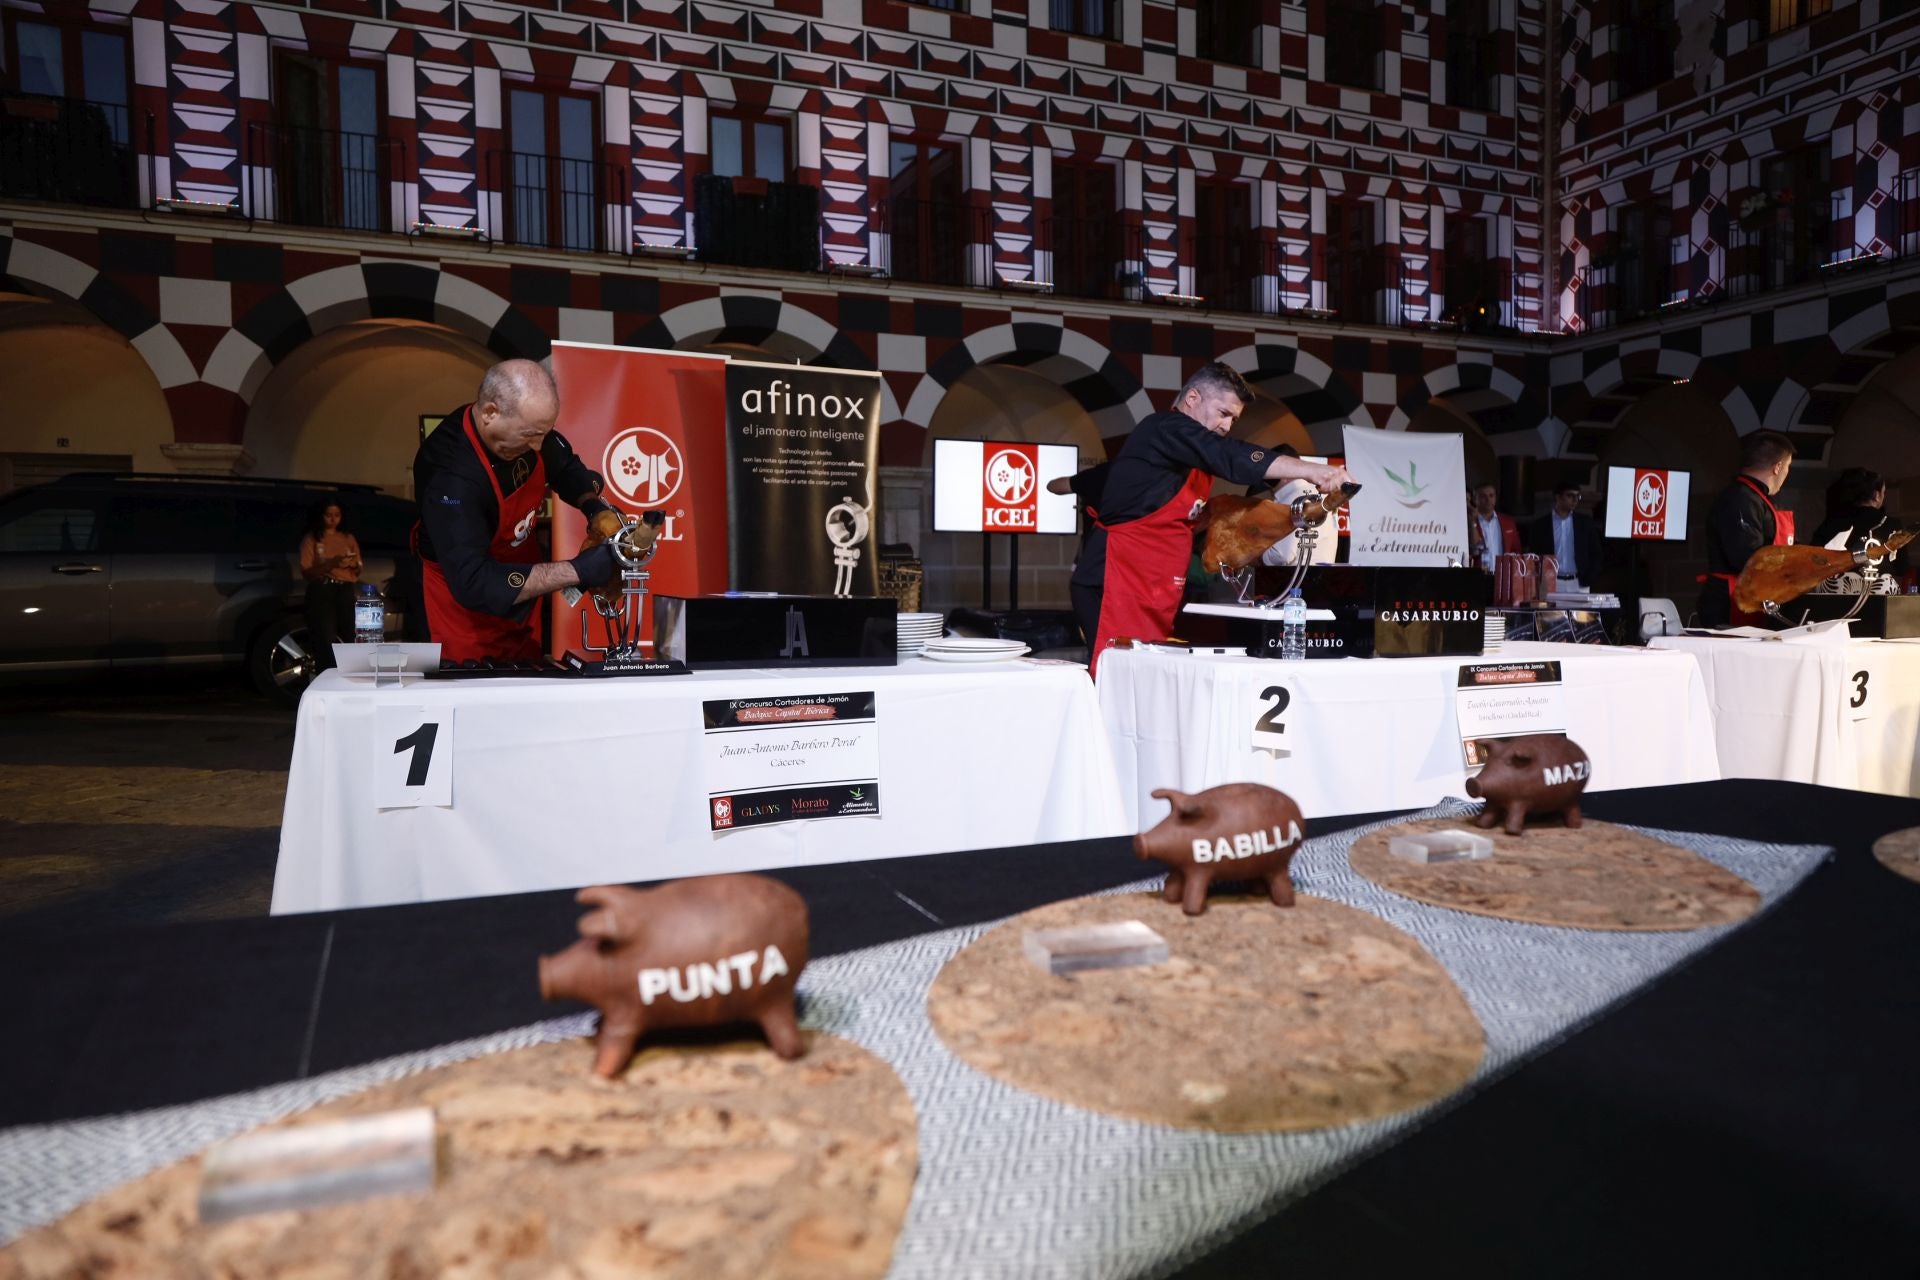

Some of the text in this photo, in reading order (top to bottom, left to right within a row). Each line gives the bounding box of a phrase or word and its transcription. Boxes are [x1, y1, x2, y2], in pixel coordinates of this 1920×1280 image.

[741, 380, 864, 420] afinox
[742, 424, 865, 442] el jamonero inteligente
[985, 508, 1035, 527] ICEL
[1368, 516, 1448, 535] Alimentos
[1633, 520, 1663, 536] ICEL
[1370, 537, 1460, 554] Extremadura
[1395, 601, 1468, 609] EUSEBIO
[1381, 610, 1480, 622] CASARRUBIO
[1268, 638, 1344, 648] CARUBIO
[1850, 670, 1870, 709] 3
[729, 695, 849, 709] IX Concurso Cortadores de Jamón
[1255, 685, 1291, 734] 2
[393, 723, 439, 786] 1
[719, 736, 862, 759] Juan Antonio Barbero Peral
[770, 758, 807, 768] Cáceres
[741, 804, 781, 818] GLADYS
[791, 797, 829, 809] Morato
[715, 818, 733, 828] ICEL
[1192, 820, 1302, 864] BABILLA
[637, 944, 789, 1006] PUNTA
